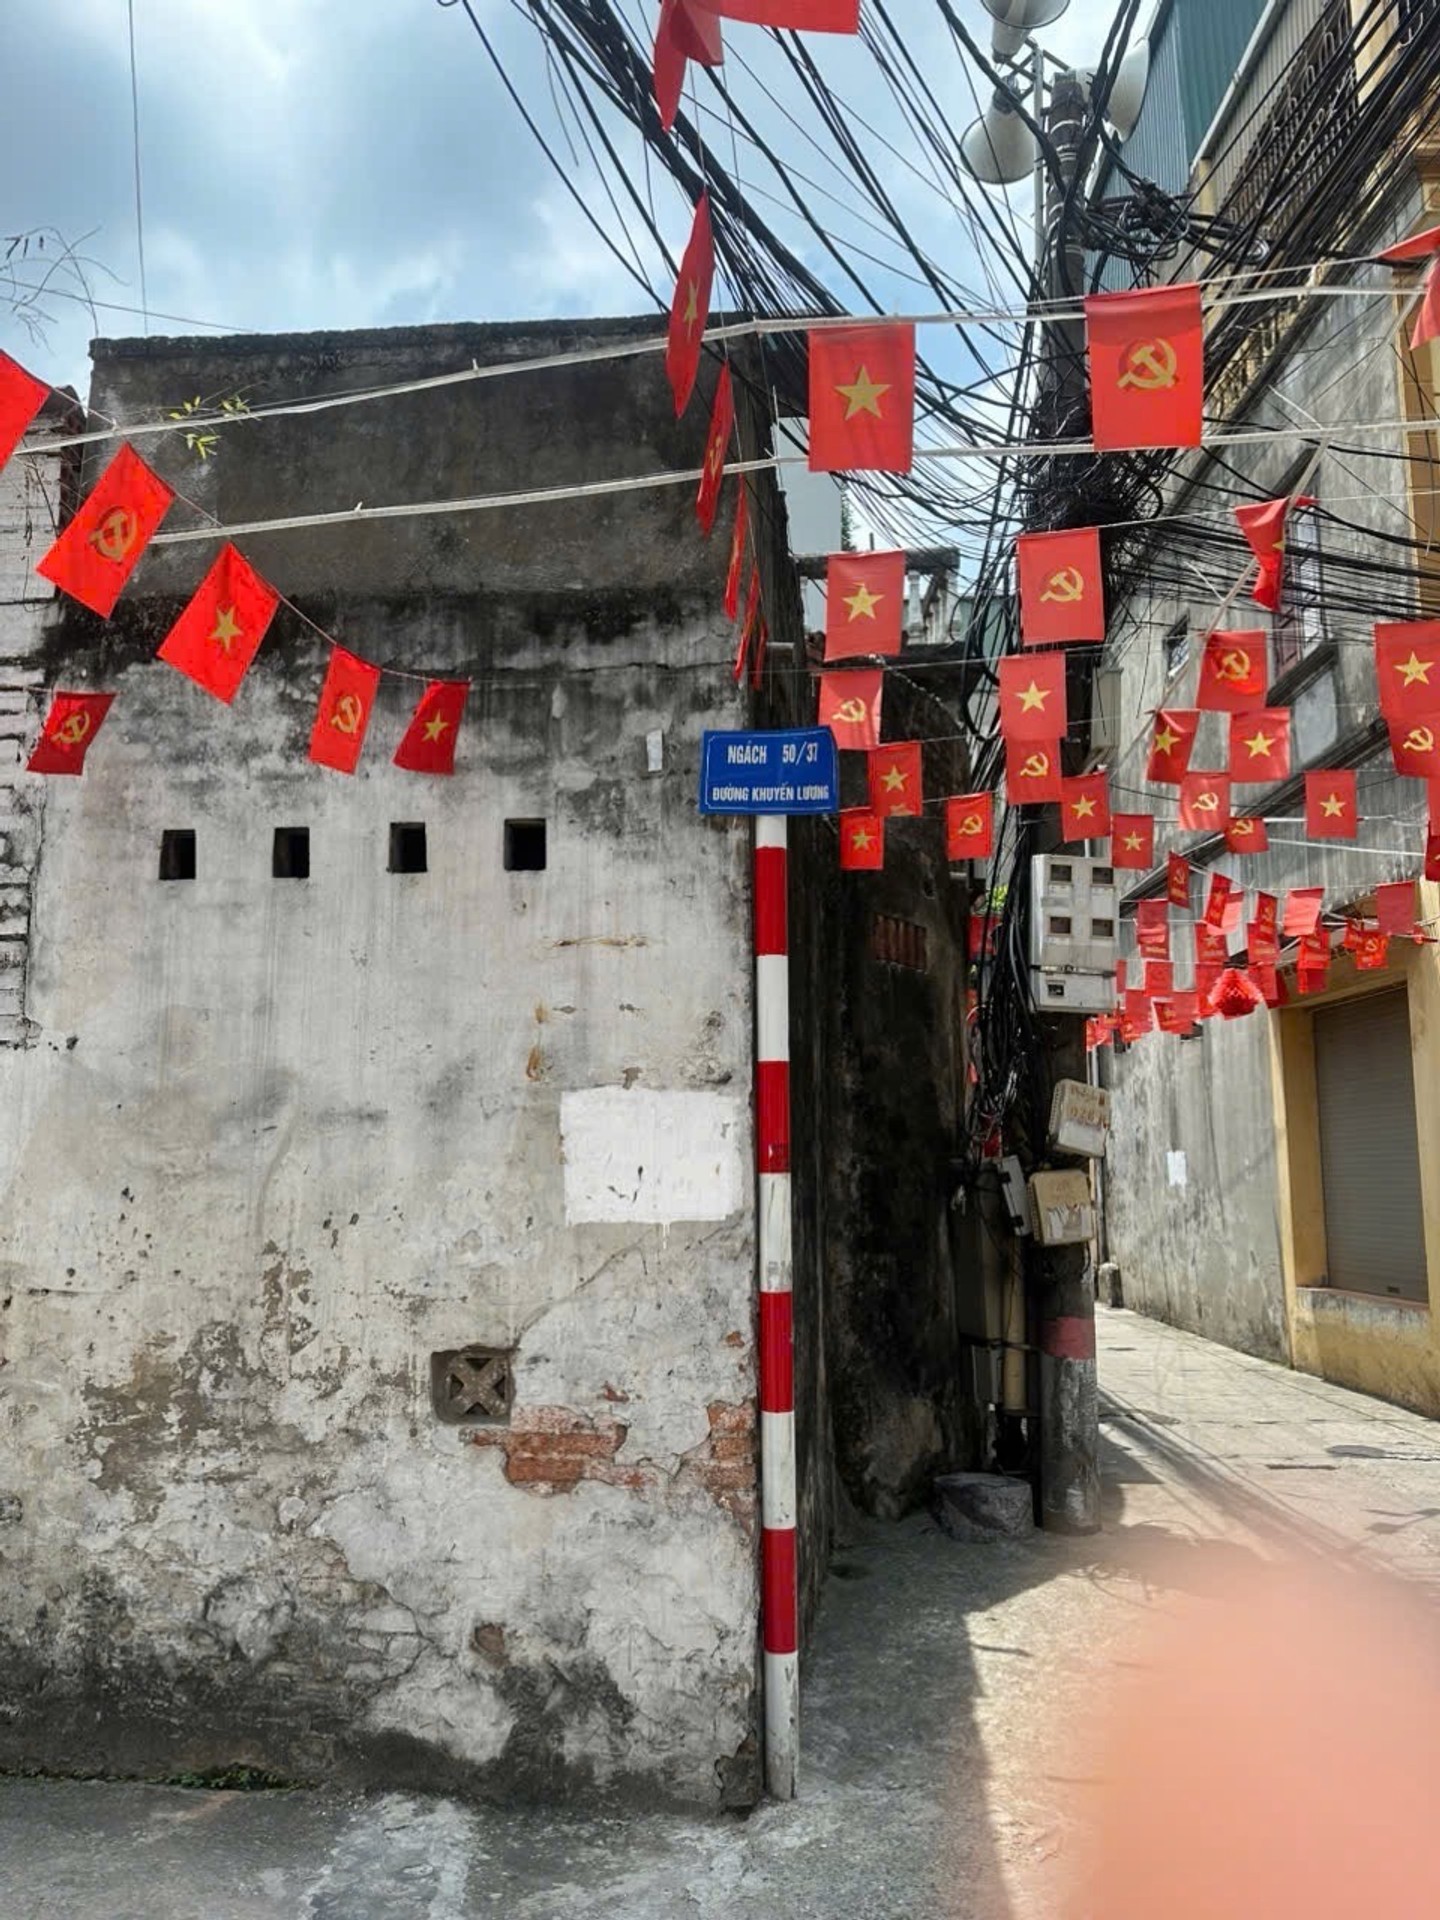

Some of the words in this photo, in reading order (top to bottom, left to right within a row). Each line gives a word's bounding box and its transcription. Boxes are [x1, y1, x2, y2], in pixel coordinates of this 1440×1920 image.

[727, 740, 767, 764] NGÁCH
[782, 741, 818, 765] 50/37
[712, 783, 749, 801] ĐƯỜNG
[752, 781, 794, 801] KHUYẾN
[797, 785, 829, 800] LƯƠNG
